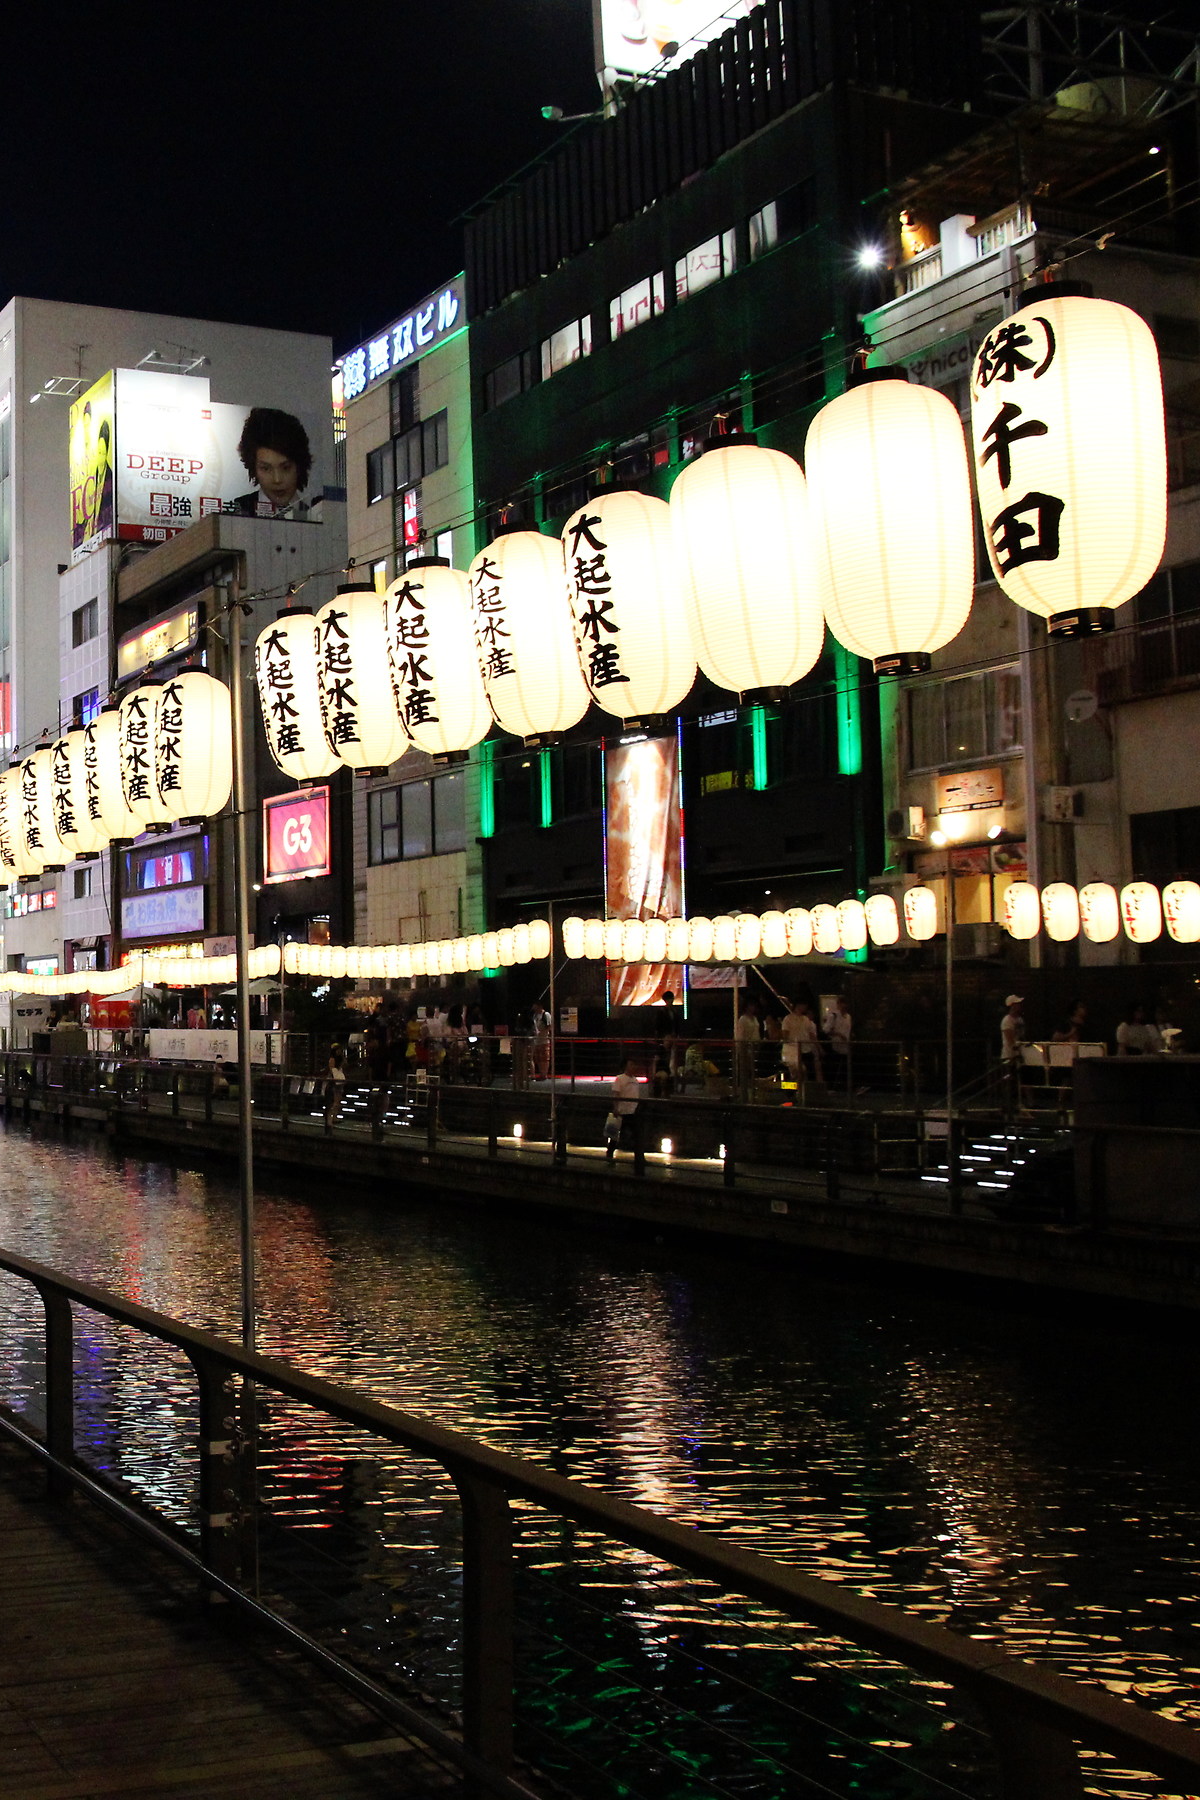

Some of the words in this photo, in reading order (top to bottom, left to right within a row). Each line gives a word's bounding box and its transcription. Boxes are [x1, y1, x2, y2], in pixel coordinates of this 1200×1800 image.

[126, 453, 204, 475] DEEP
[140, 470, 191, 485] Group
[151, 494, 192, 518] 最強
[143, 527, 167, 541] 初回
[474, 557, 516, 681] 大起水産
[568, 514, 631, 688] 大起水産
[264, 629, 305, 756] 大起水産
[322, 609, 361, 745] 大起水産
[394, 580, 440, 726] 大起水産
[52, 740, 78, 836] 大起水産
[126, 694, 151, 802] 大起水産
[160, 682, 184, 793] 大起水産
[21, 758, 44, 850] 大起水産
[283, 813, 312, 856] G3
